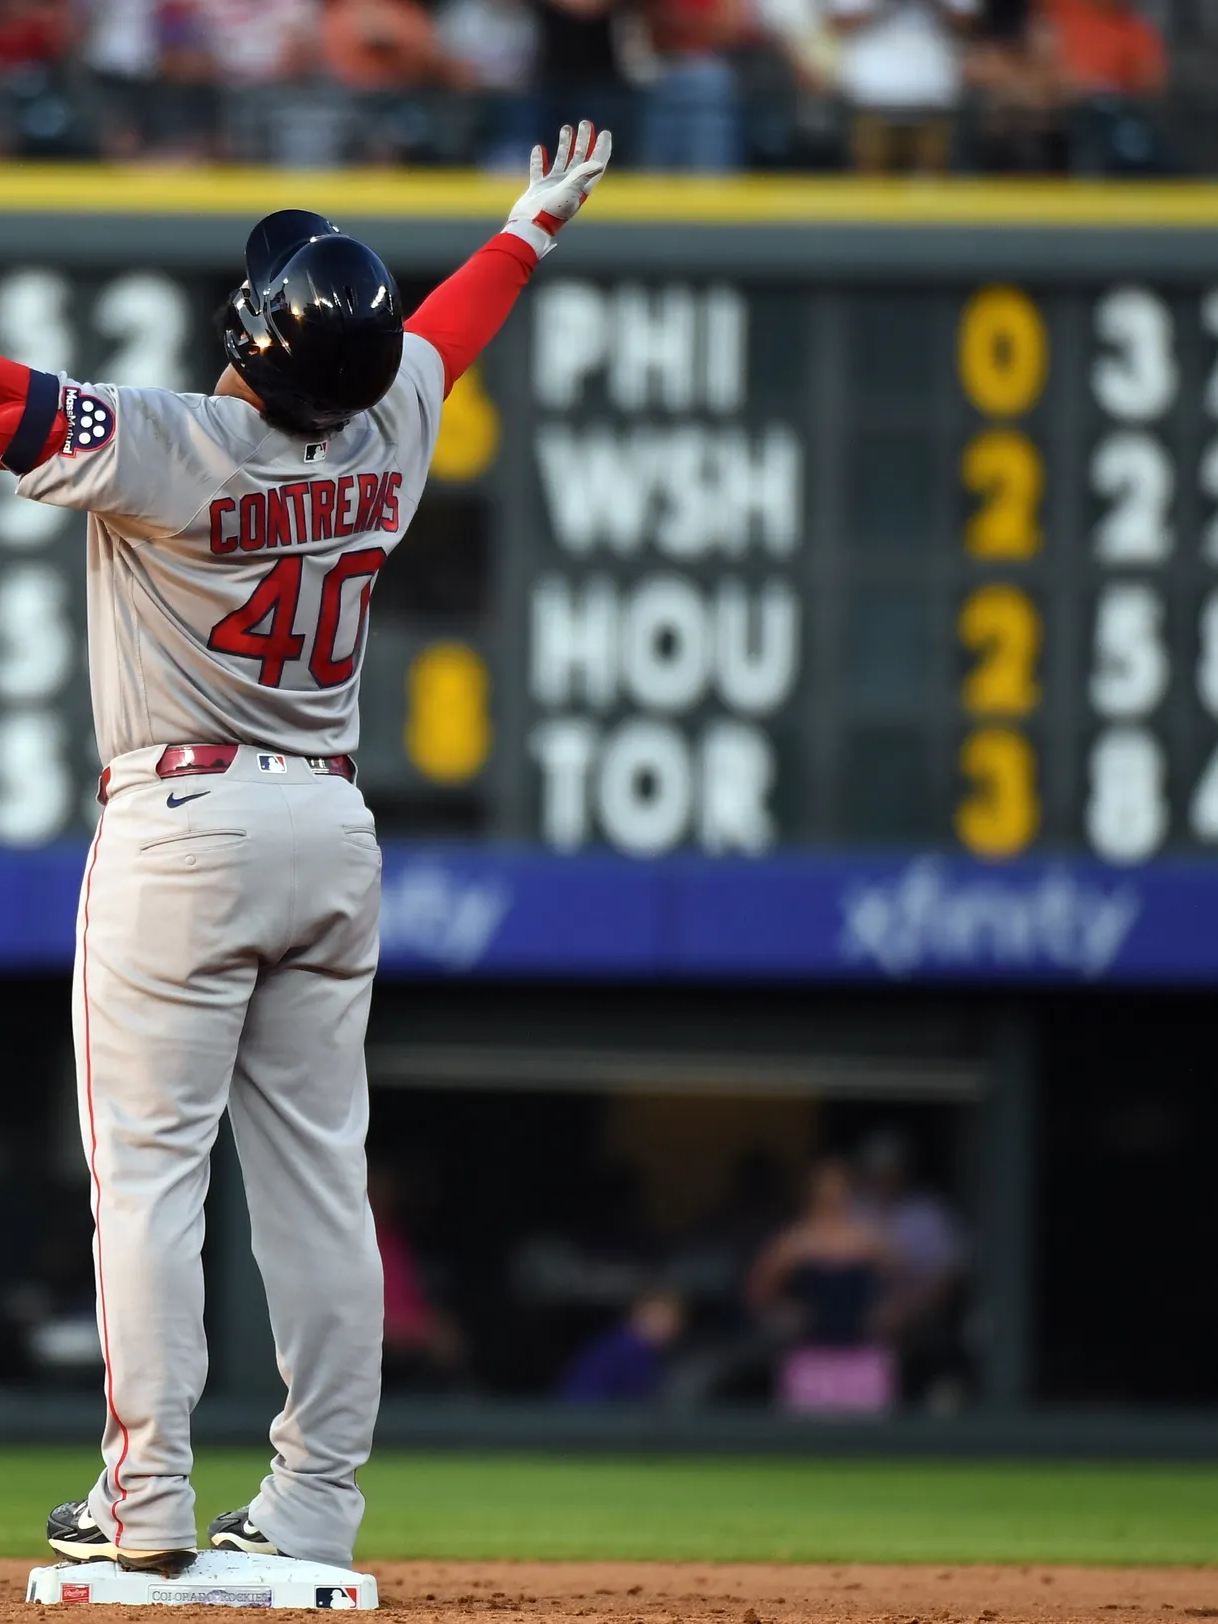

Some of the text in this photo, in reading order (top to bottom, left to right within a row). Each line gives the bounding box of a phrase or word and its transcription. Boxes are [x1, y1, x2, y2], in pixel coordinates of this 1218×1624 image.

[93, 274, 190, 392] 2
[530, 280, 746, 411] PHI
[958, 286, 1048, 417] 0
[1091, 285, 1180, 421] 3
[210, 471, 402, 554] CONTRERAS
[534, 423, 802, 557] WSH
[960, 430, 1046, 560] 2
[1089, 430, 1178, 565] 2
[207, 547, 388, 689] 40
[529, 575, 799, 715] HOU
[959, 584, 1044, 715] 2
[1089, 582, 1172, 720] 5
[530, 722, 777, 857] TOR
[956, 726, 1040, 858] 3
[838, 858, 1142, 978] xfinity
